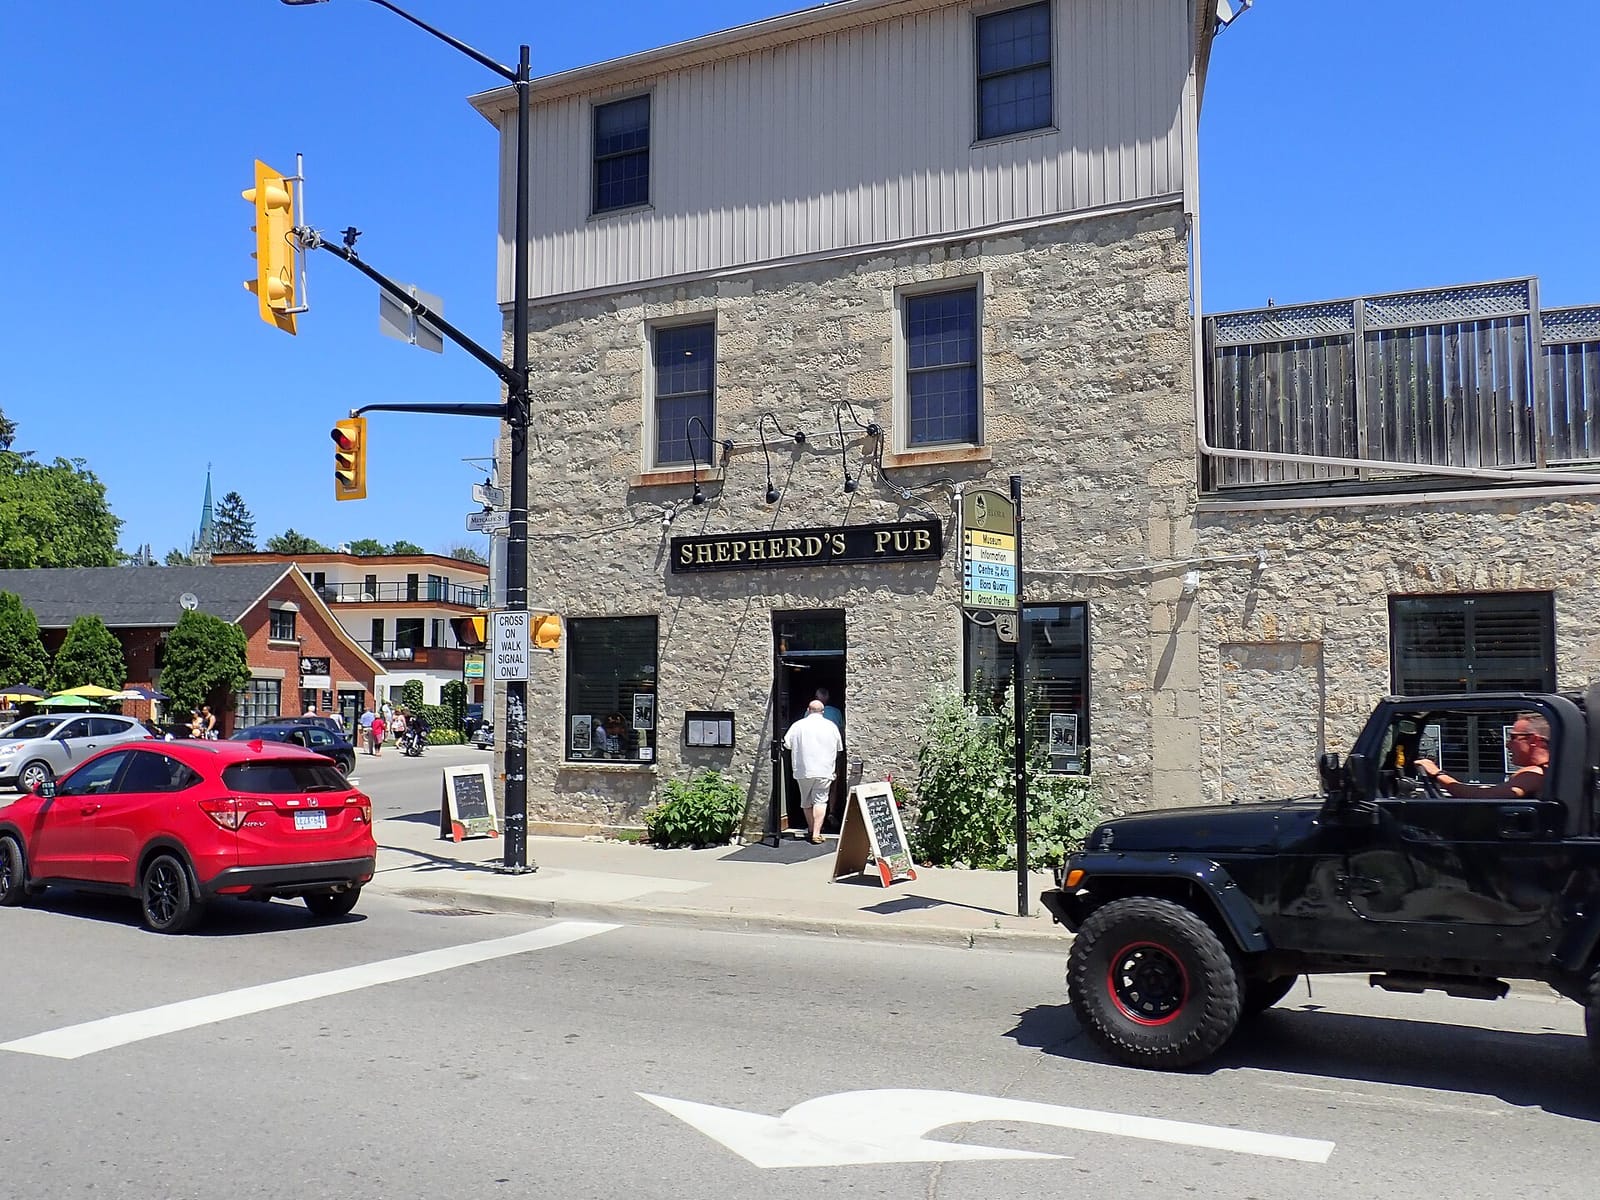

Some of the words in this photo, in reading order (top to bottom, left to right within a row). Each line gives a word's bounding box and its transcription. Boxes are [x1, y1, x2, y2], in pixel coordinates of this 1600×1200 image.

[983, 534, 1001, 545] Museum
[680, 533, 846, 565] SHEPHERD'S
[874, 529, 932, 553] PUB
[981, 549, 1006, 561] Information
[978, 564, 993, 575] Centre
[1000, 568, 1010, 577] Arts
[980, 580, 991, 589] Elora
[993, 581, 1008, 593] Quarry
[978, 594, 992, 604] Grand
[994, 596, 1010, 606] Theatre
[500, 616, 523, 626] CROSS
[505, 629, 515, 638] ON
[501, 641, 521, 650] WALK
[498, 654, 524, 664] SIGNAL
[501, 667, 518, 677] ONLY
